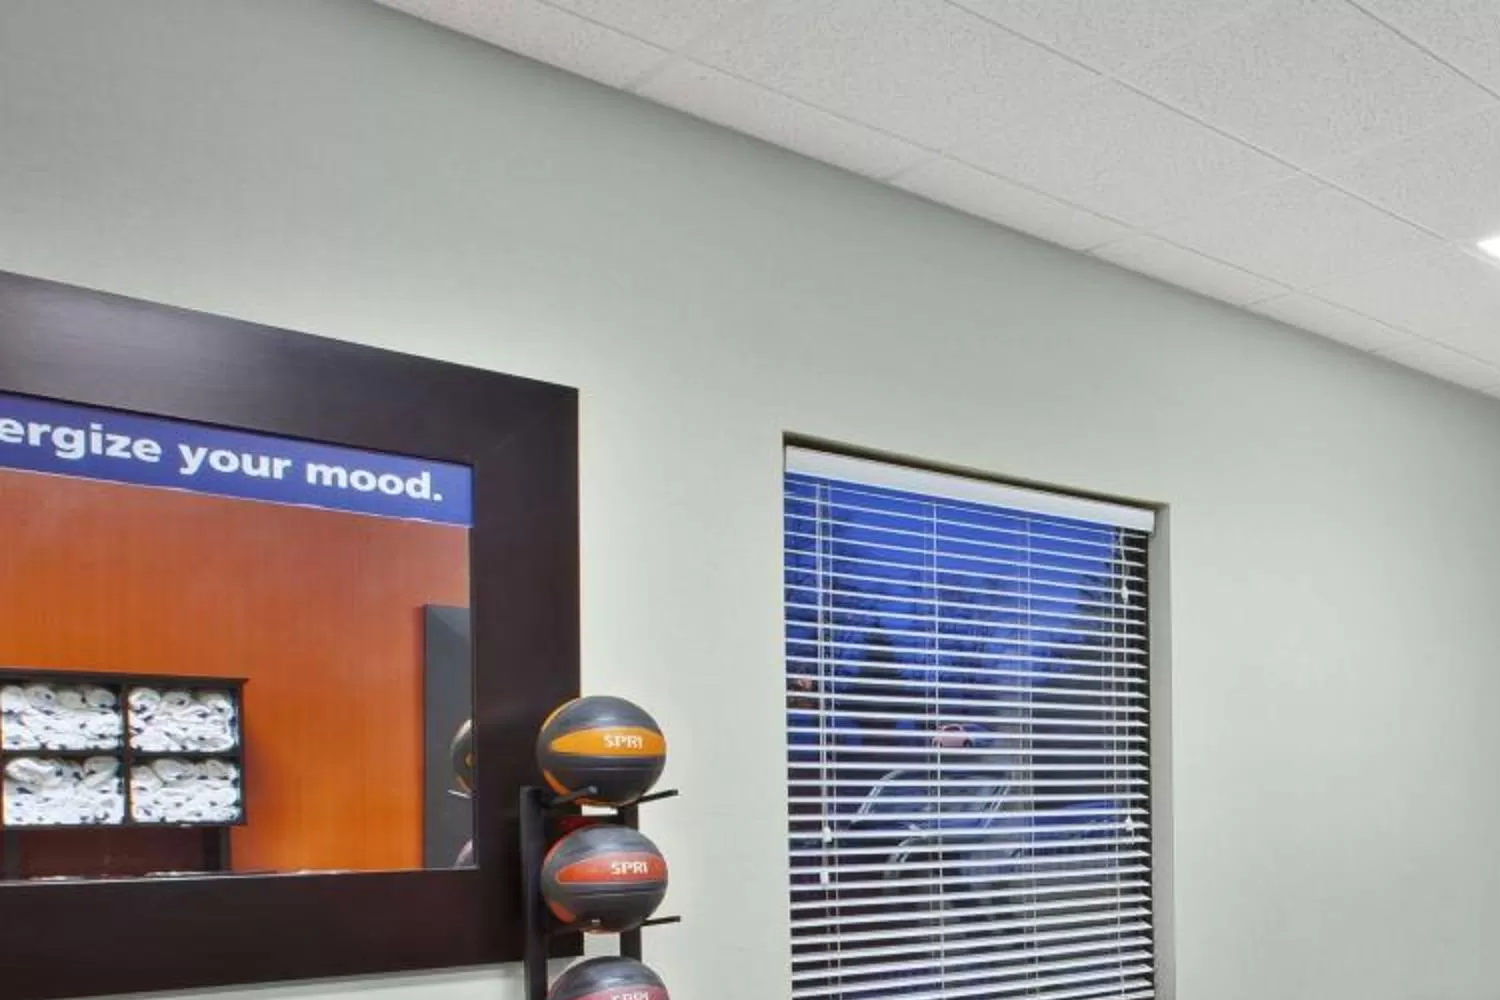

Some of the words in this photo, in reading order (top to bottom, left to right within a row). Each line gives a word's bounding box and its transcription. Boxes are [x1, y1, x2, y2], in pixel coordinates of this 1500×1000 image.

[0, 418, 161, 461] ergize
[178, 443, 292, 480] your
[305, 460, 443, 502] mood.
[603, 734, 643, 749] SPRI
[611, 860, 648, 875] SPRI
